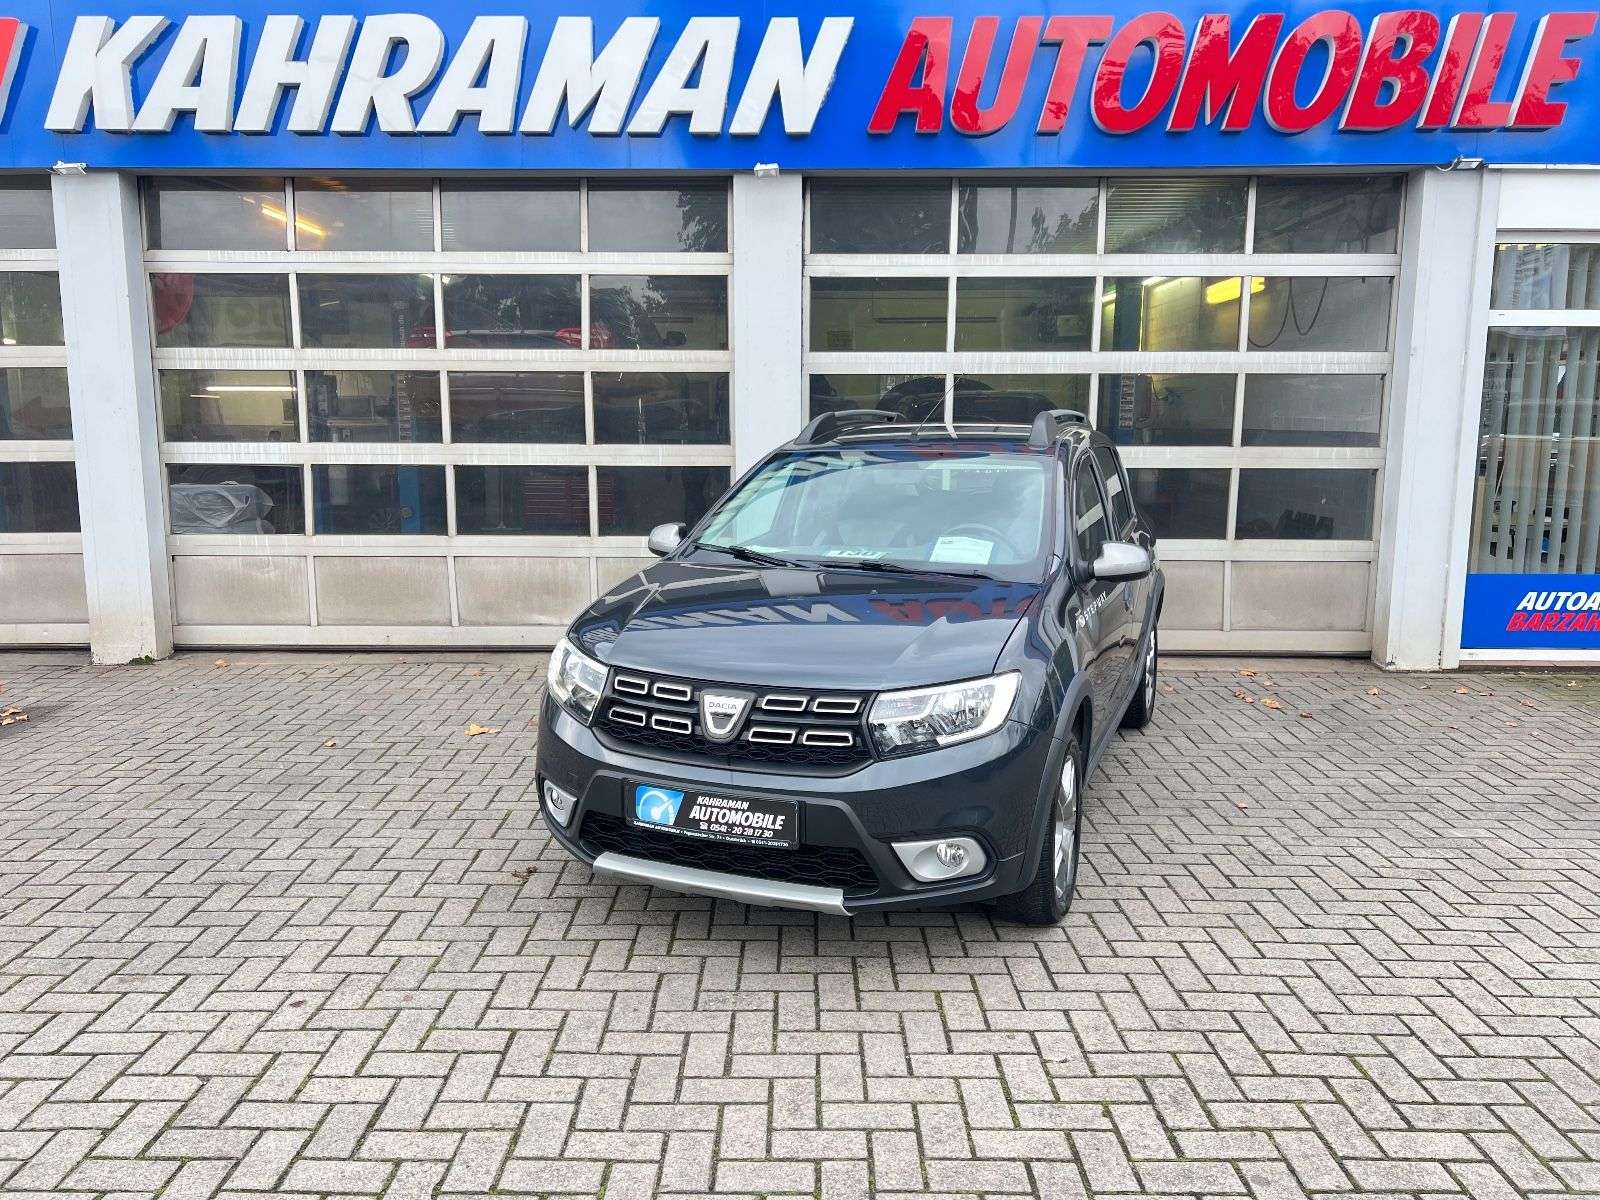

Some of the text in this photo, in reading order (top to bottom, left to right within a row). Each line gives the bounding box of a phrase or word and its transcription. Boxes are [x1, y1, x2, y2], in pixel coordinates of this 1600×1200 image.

[44, 11, 1598, 136] KAHRAMAN AUTOMOBILE
[1083, 591, 1107, 621] STEPWAY
[1516, 591, 1600, 611] AUTOA
[708, 701, 737, 710] DACIA
[697, 795, 750, 810] KAHRAMAN
[689, 806, 785, 830] AUTOMOBILE
[710, 823, 728, 833] 0541
[732, 826, 743, 834] 20
[743, 828, 754, 836] 28
[754, 829, 763, 837] 17
[762, 830, 774, 838] 30
